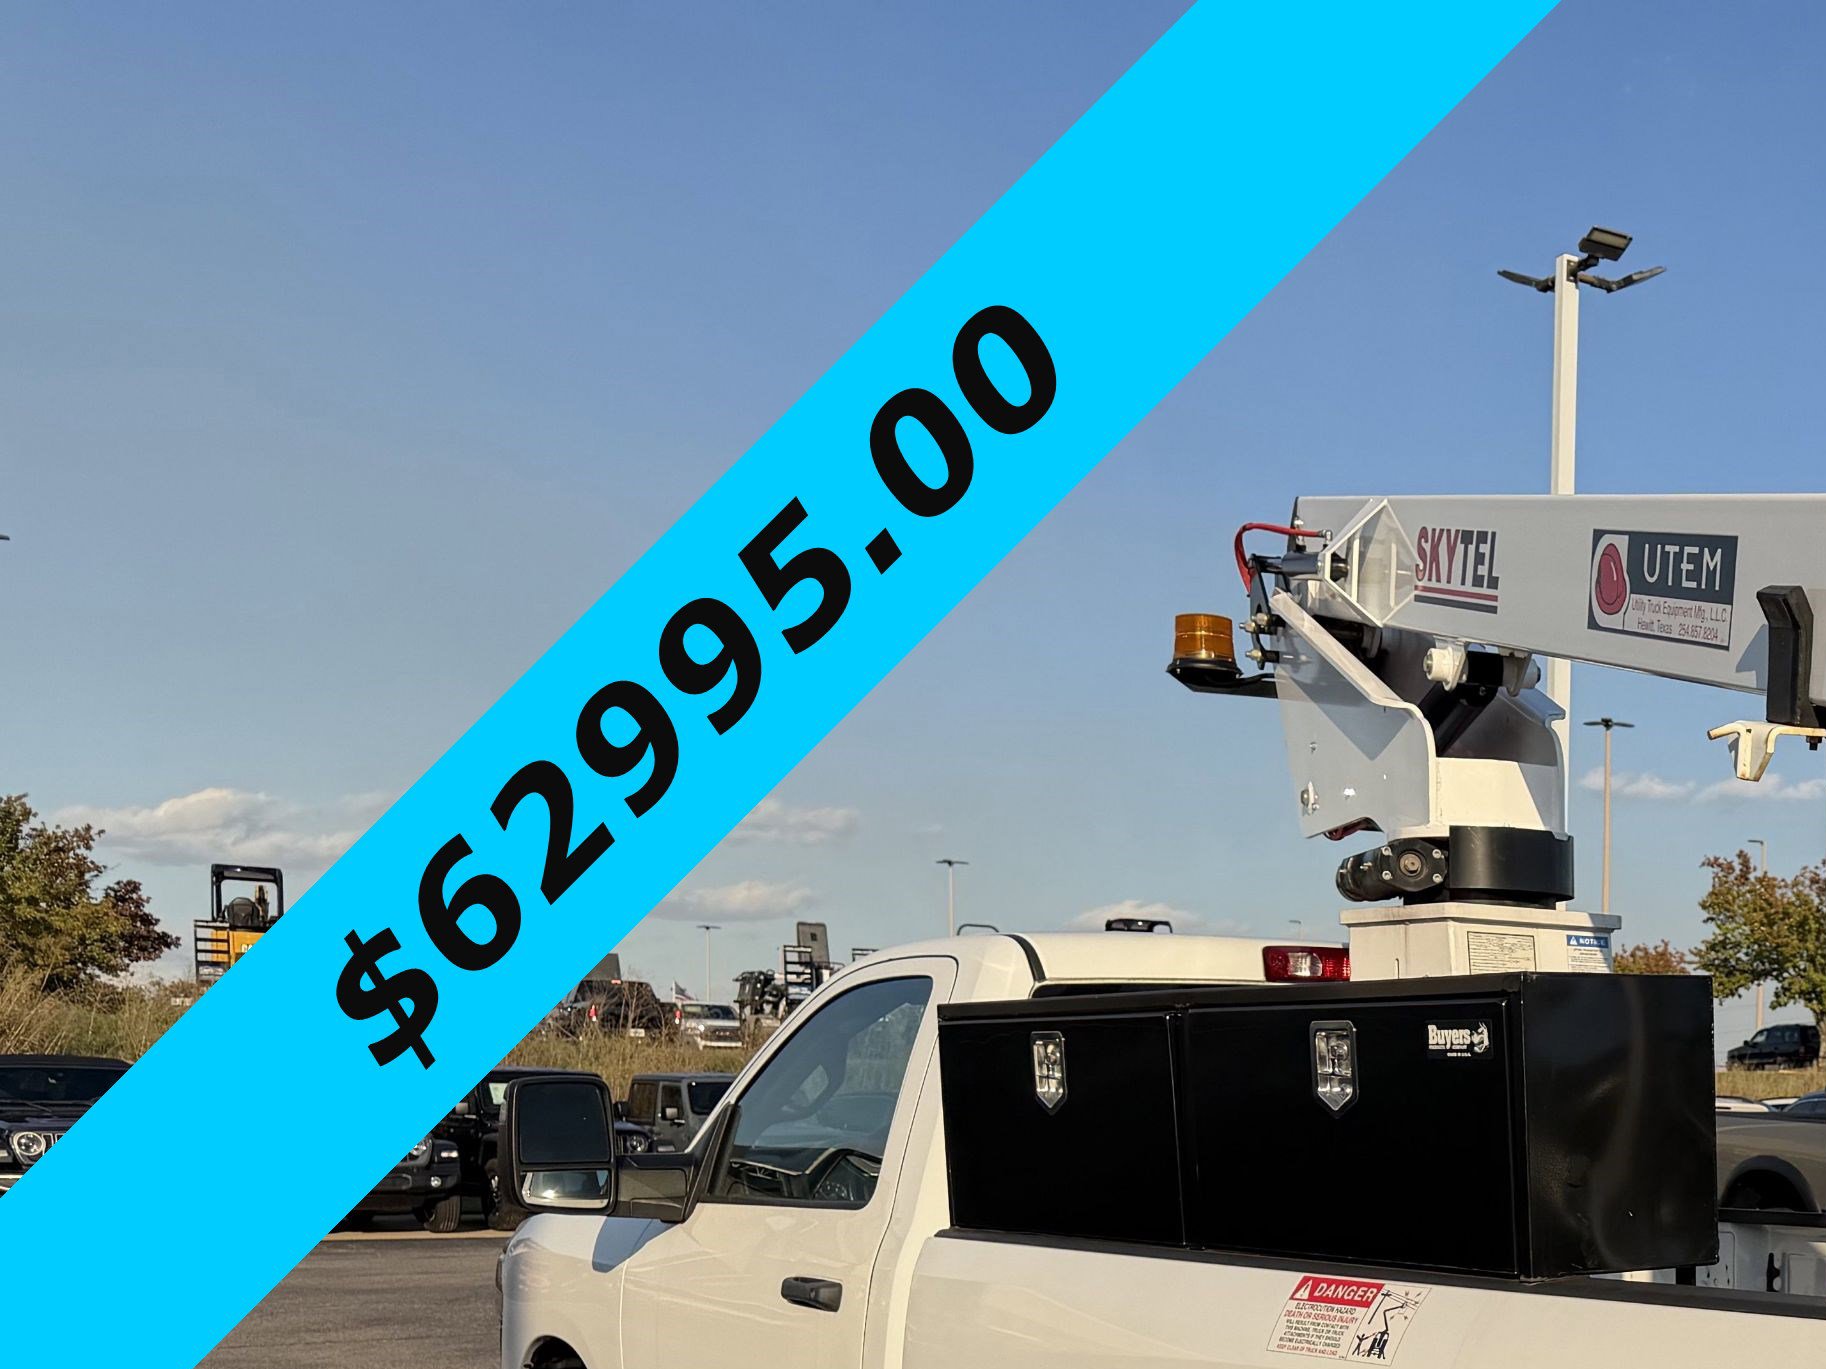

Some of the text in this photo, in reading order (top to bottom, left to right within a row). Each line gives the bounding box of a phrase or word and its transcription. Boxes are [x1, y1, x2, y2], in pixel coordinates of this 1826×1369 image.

[1415, 526, 1500, 590] SKYTEL
[1643, 543, 1722, 591] UTEM
[1648, 599, 1661, 614] Truck
[1663, 601, 1693, 619] Equipment
[1657, 619, 1672, 634] Texas
[1428, 1025, 1471, 1049] Buyers
[1313, 1283, 1377, 1302] DANGER
[1284, 1310, 1303, 1318] DEATH
[1312, 1313, 1337, 1322] SERIOUS
[1337, 1316, 1358, 1324] INJURY
[1295, 1302, 1356, 1315] ELECTROCUTION HAZARD
